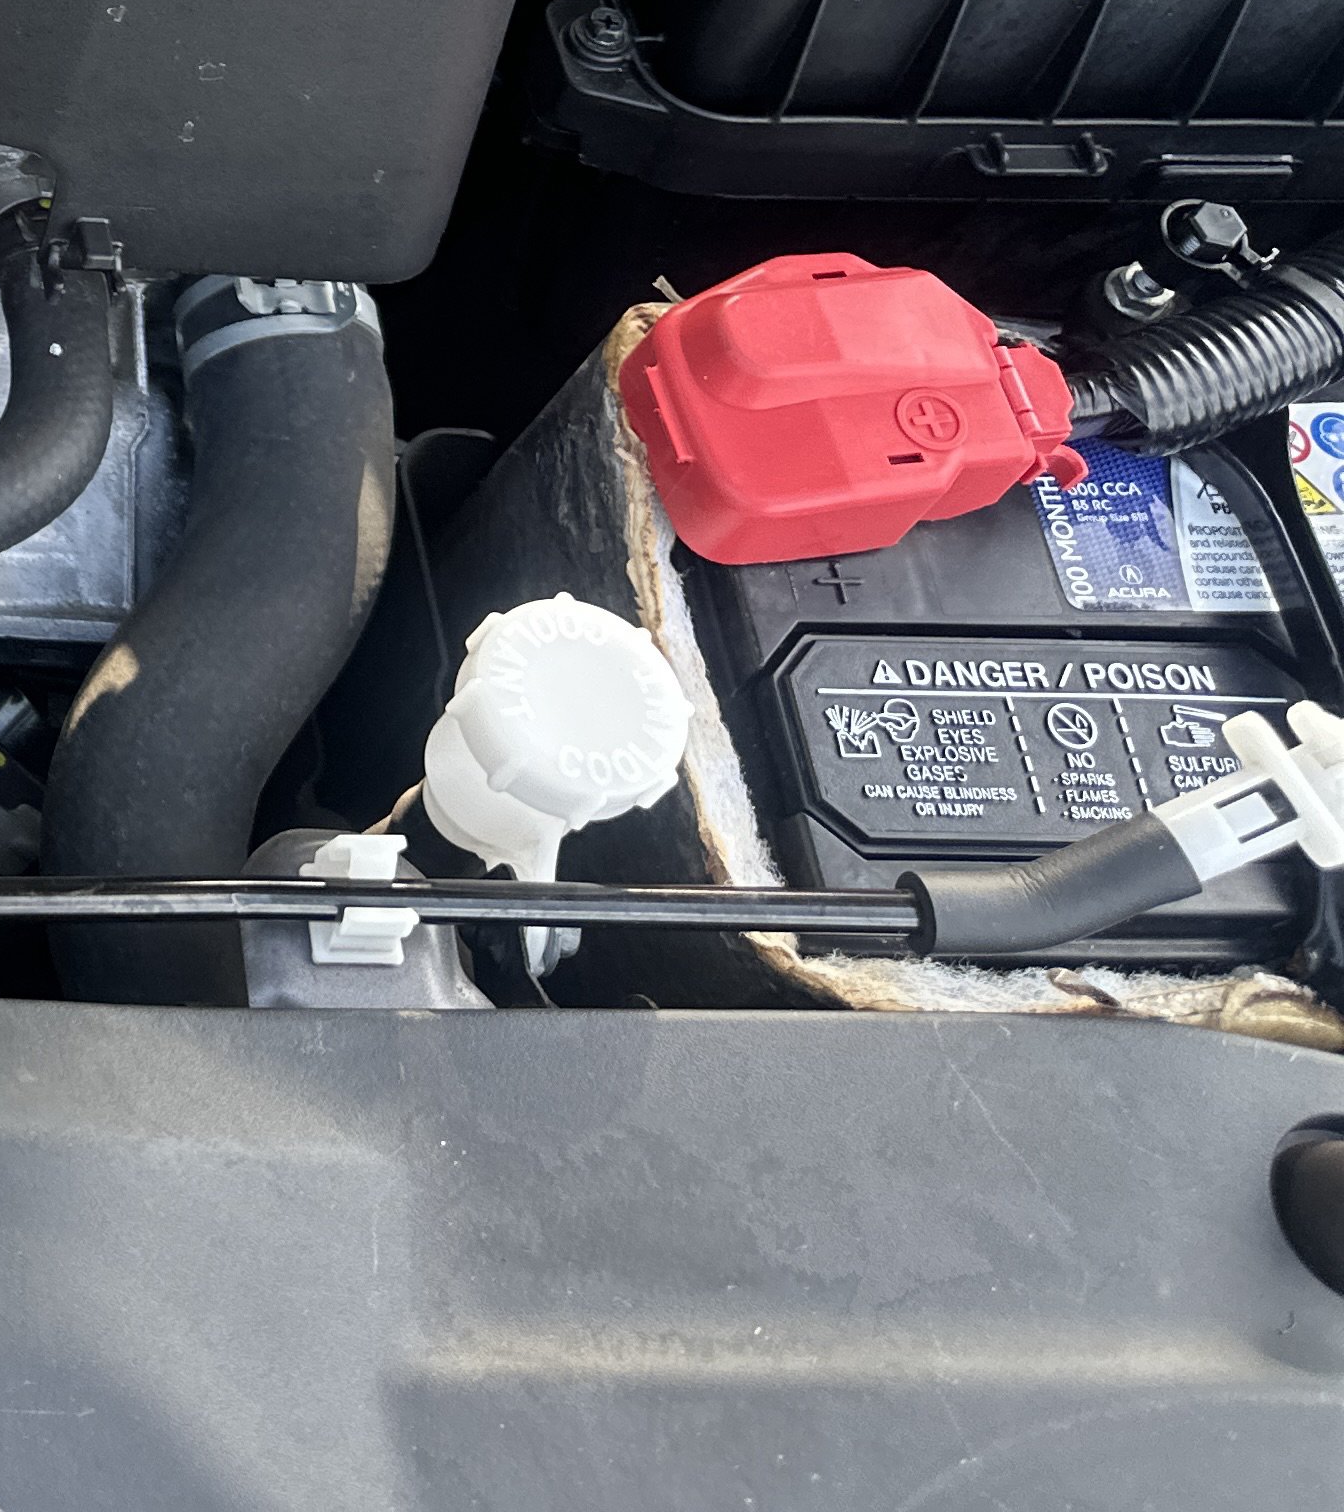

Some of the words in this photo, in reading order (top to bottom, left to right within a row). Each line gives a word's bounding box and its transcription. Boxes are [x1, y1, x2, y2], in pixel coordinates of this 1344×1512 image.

[1102, 481, 1143, 496] CCA
[1092, 499, 1112, 511] RC
[1190, 539, 1211, 548] and
[1192, 565, 1204, 574] to
[1206, 565, 1237, 575] cause
[1065, 566, 1098, 609] 100
[1108, 587, 1171, 599] ACURA
[1197, 590, 1210, 600] to
[1212, 590, 1243, 600] cause
[905, 659, 1050, 688] DANGER
[1058, 662, 1074, 688] /
[1083, 662, 1216, 691] POISON
[931, 709, 997, 726] SHIELD
[937, 728, 985, 745] EYES
[900, 745, 999, 763] EXPLOSIVE
[1066, 751, 1096, 769] NO
[906, 764, 968, 782] GASES
[1061, 772, 1116, 787] SPARKS
[864, 784, 894, 799] CAN
[896, 785, 941, 800] CAUSE
[943, 786, 1018, 801] BLINDNESS
[1065, 789, 1120, 804] FLAMES
[915, 802, 936, 816] OR
[938, 802, 985, 817] INJURY
